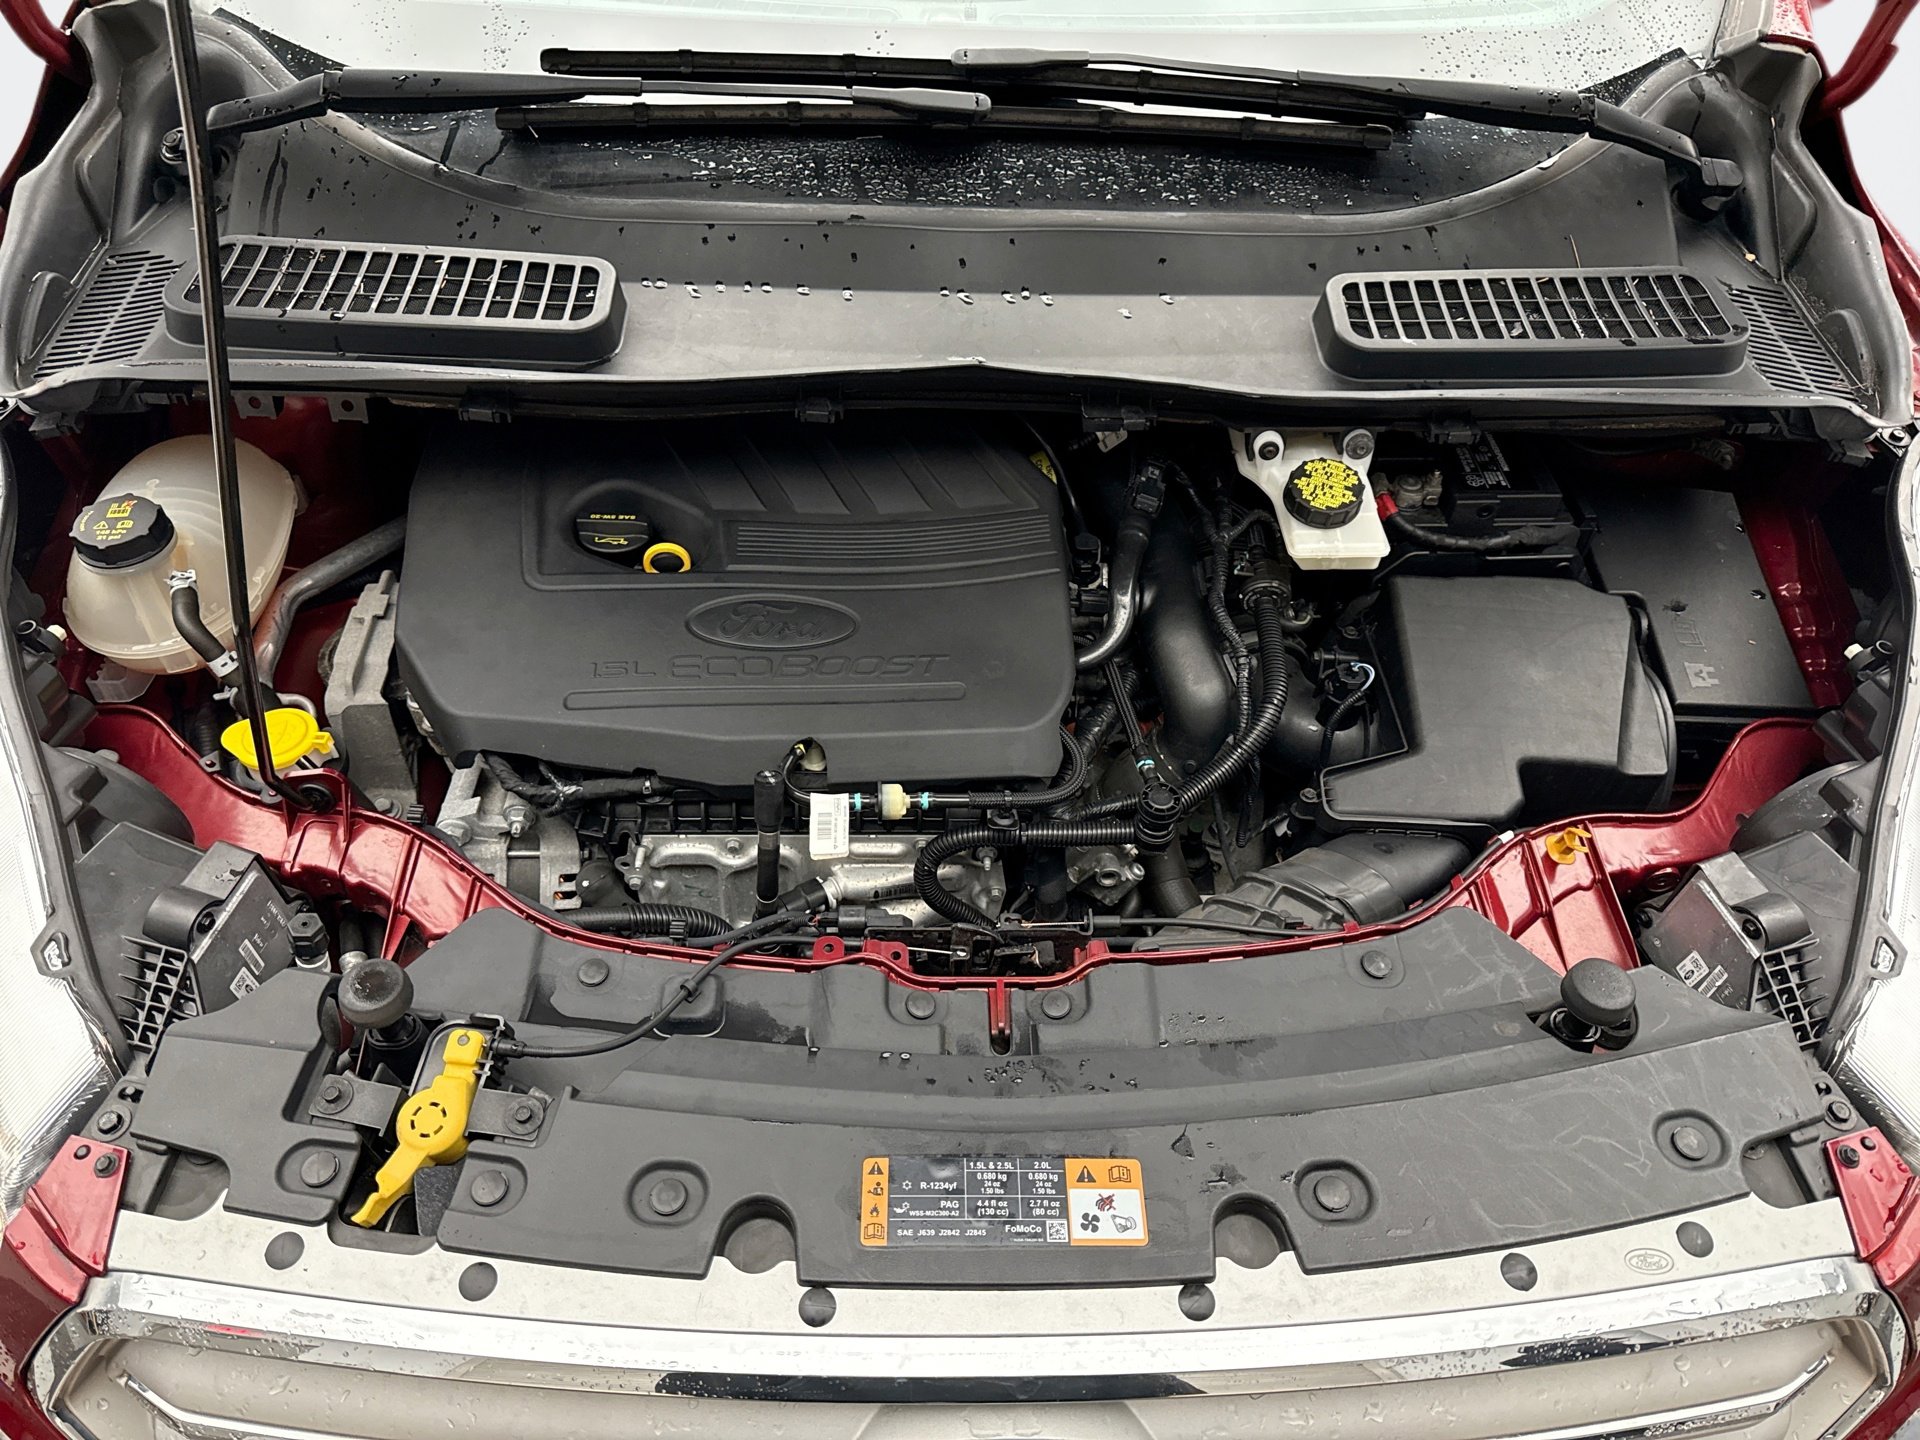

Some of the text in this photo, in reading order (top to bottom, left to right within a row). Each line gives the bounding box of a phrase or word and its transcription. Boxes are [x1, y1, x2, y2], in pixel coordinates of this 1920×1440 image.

[719, 602, 826, 641] Ford
[969, 1161, 1015, 1169] 1.5L & 2.5L
[1033, 1161, 1052, 1169] 2.0L
[976, 1172, 1008, 1182] 0.680 kg
[1028, 1172, 1059, 1182] 0.680 kg
[920, 1182, 958, 1192] R-1234yf
[940, 1200, 960, 1208] PAG
[976, 1199, 990, 1207] 4.4
[990, 1199, 997, 1207] fl
[1029, 1199, 1042, 1207] 2.7
[1042, 1199, 1049, 1207] fl
[977, 1208, 1009, 1217] (130 cc)
[1032, 1208, 1060, 1217] (80 cc)
[1005, 1224, 1042, 1233] FoMoCo
